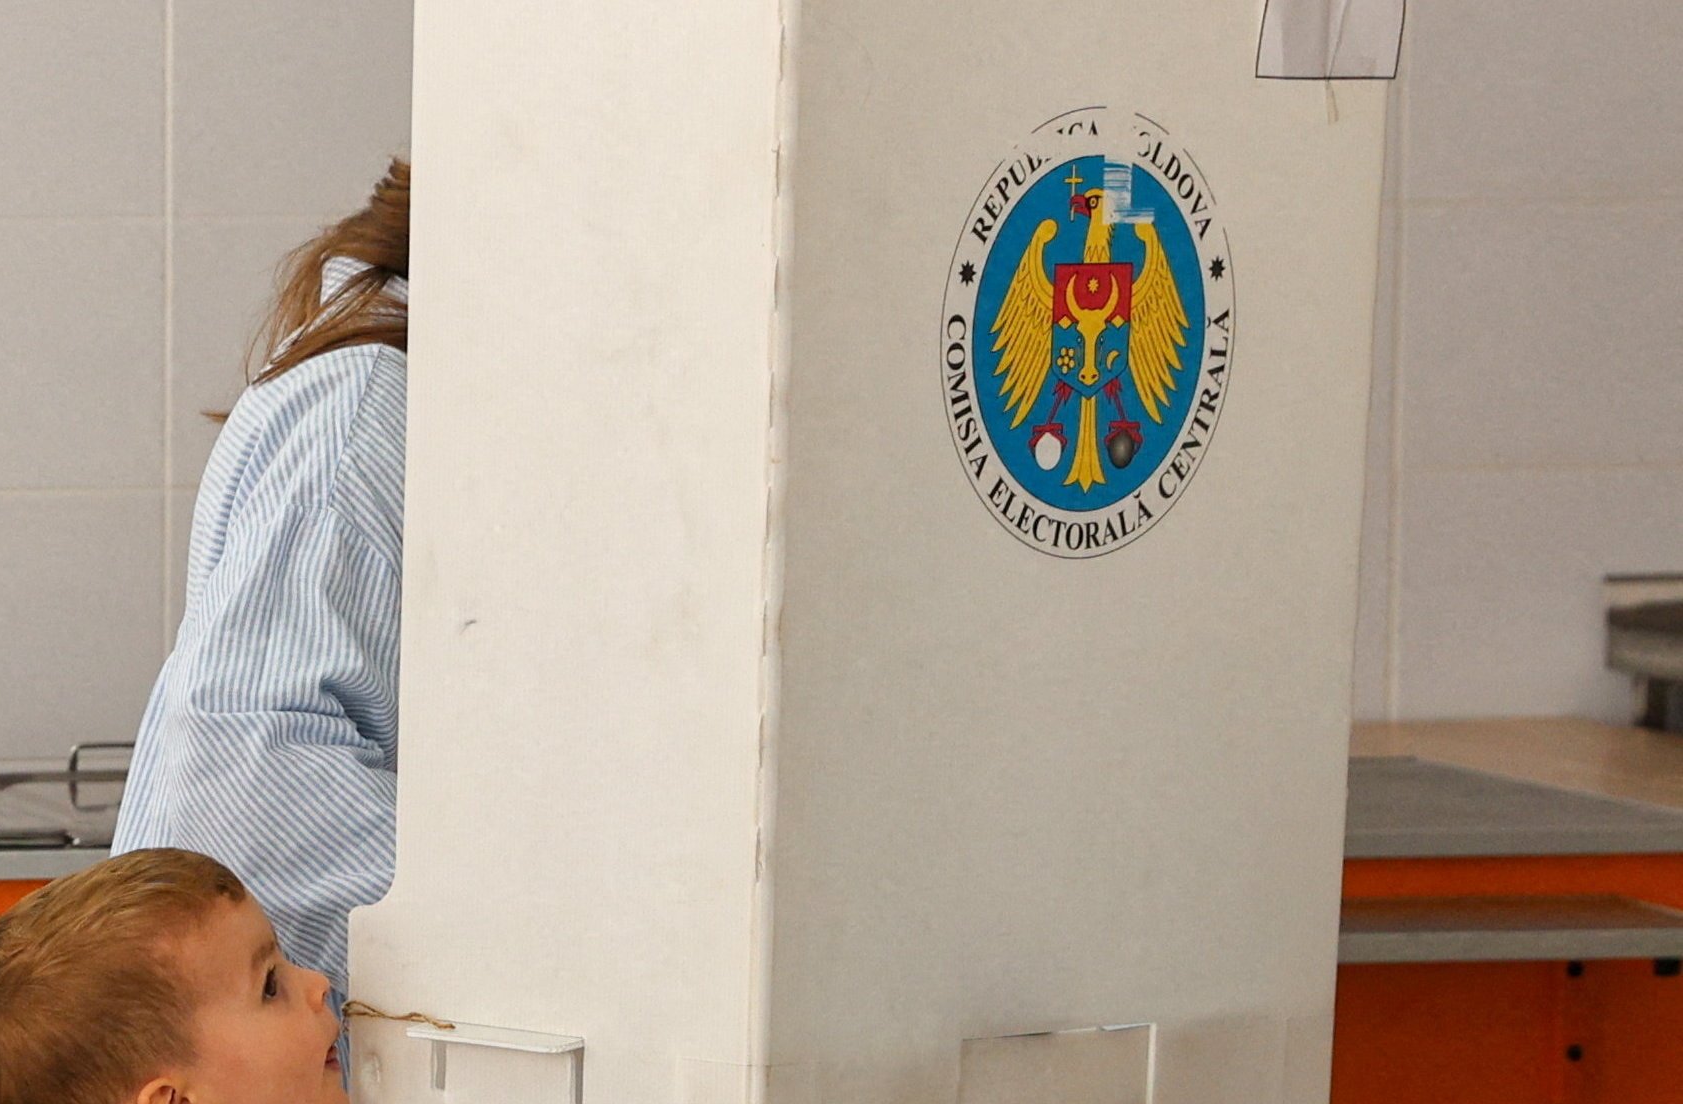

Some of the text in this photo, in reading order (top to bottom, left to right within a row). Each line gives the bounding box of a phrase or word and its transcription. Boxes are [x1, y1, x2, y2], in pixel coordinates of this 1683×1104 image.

[1133, 125, 1212, 240] OLDOVA
[945, 308, 1230, 550] COMISIA ELECTORALĂ CENTRALĂ
